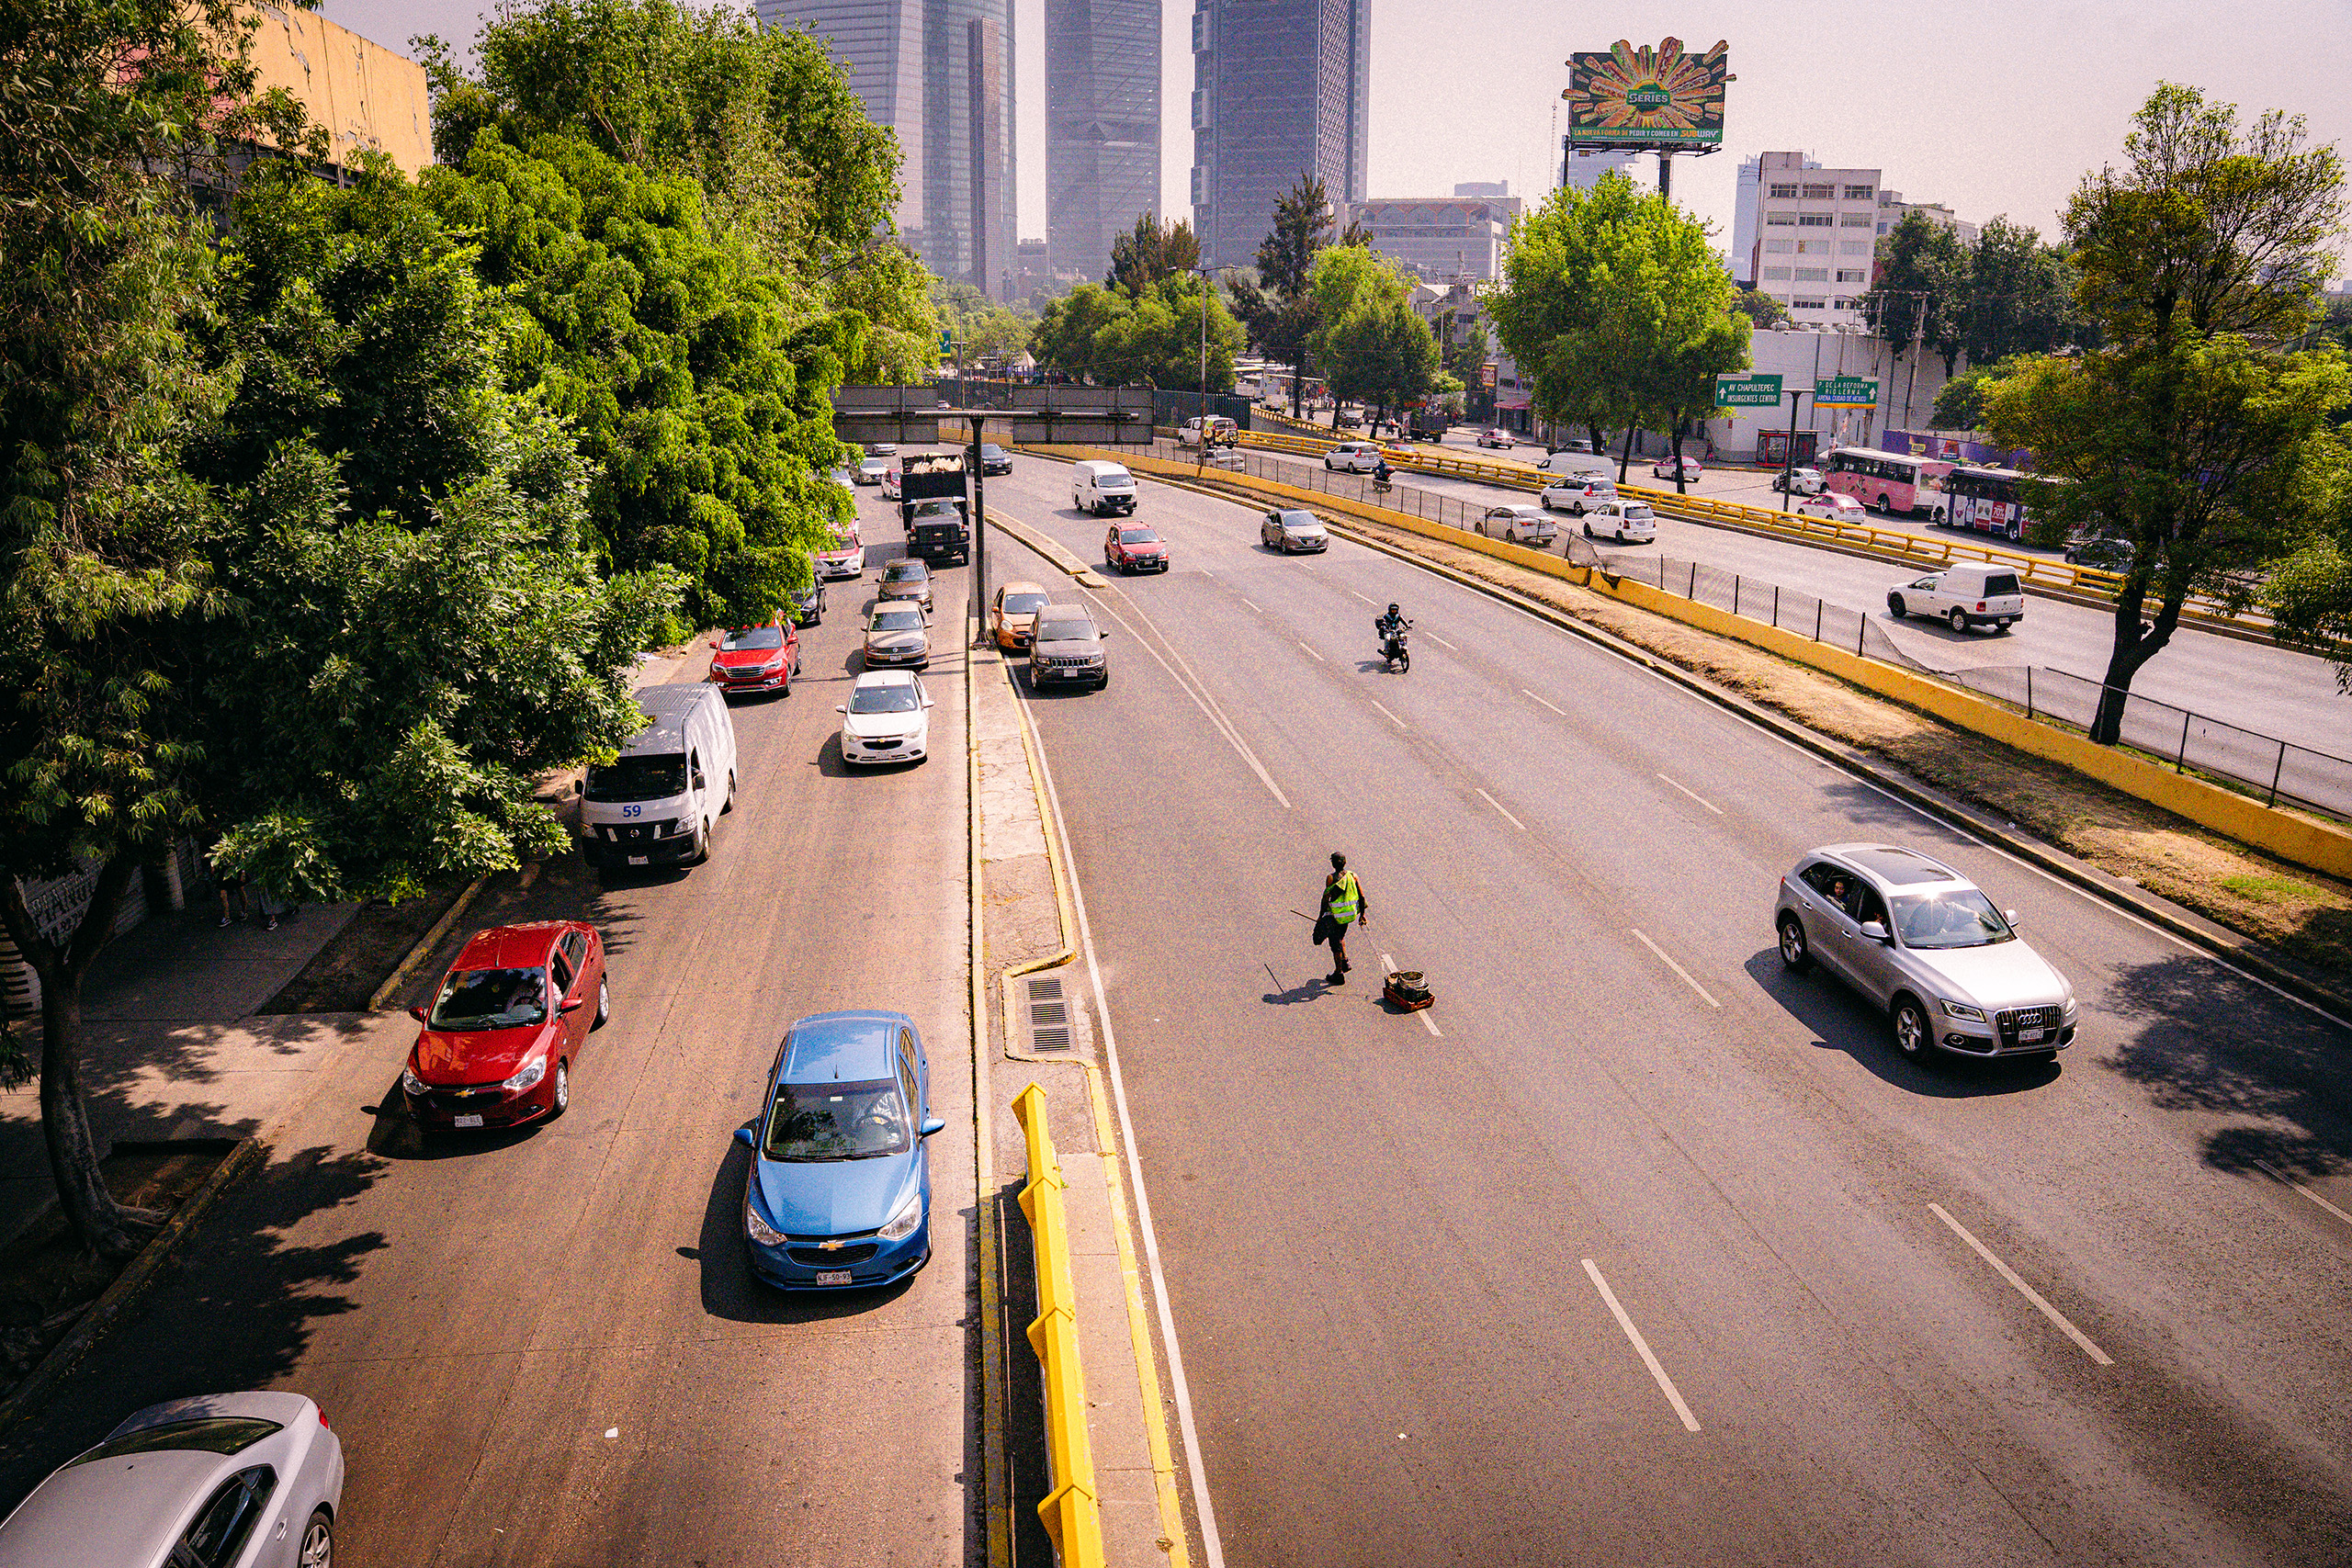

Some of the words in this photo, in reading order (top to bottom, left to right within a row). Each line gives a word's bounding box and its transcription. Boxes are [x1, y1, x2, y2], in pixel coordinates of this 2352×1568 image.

[1629, 93, 1668, 103] SERIES
[1679, 130, 1718, 138] SUBWAY
[1737, 384, 1775, 392] CHAPULTEPEC
[1993, 506, 2006, 517] 70%
[623, 805, 641, 818] 59
